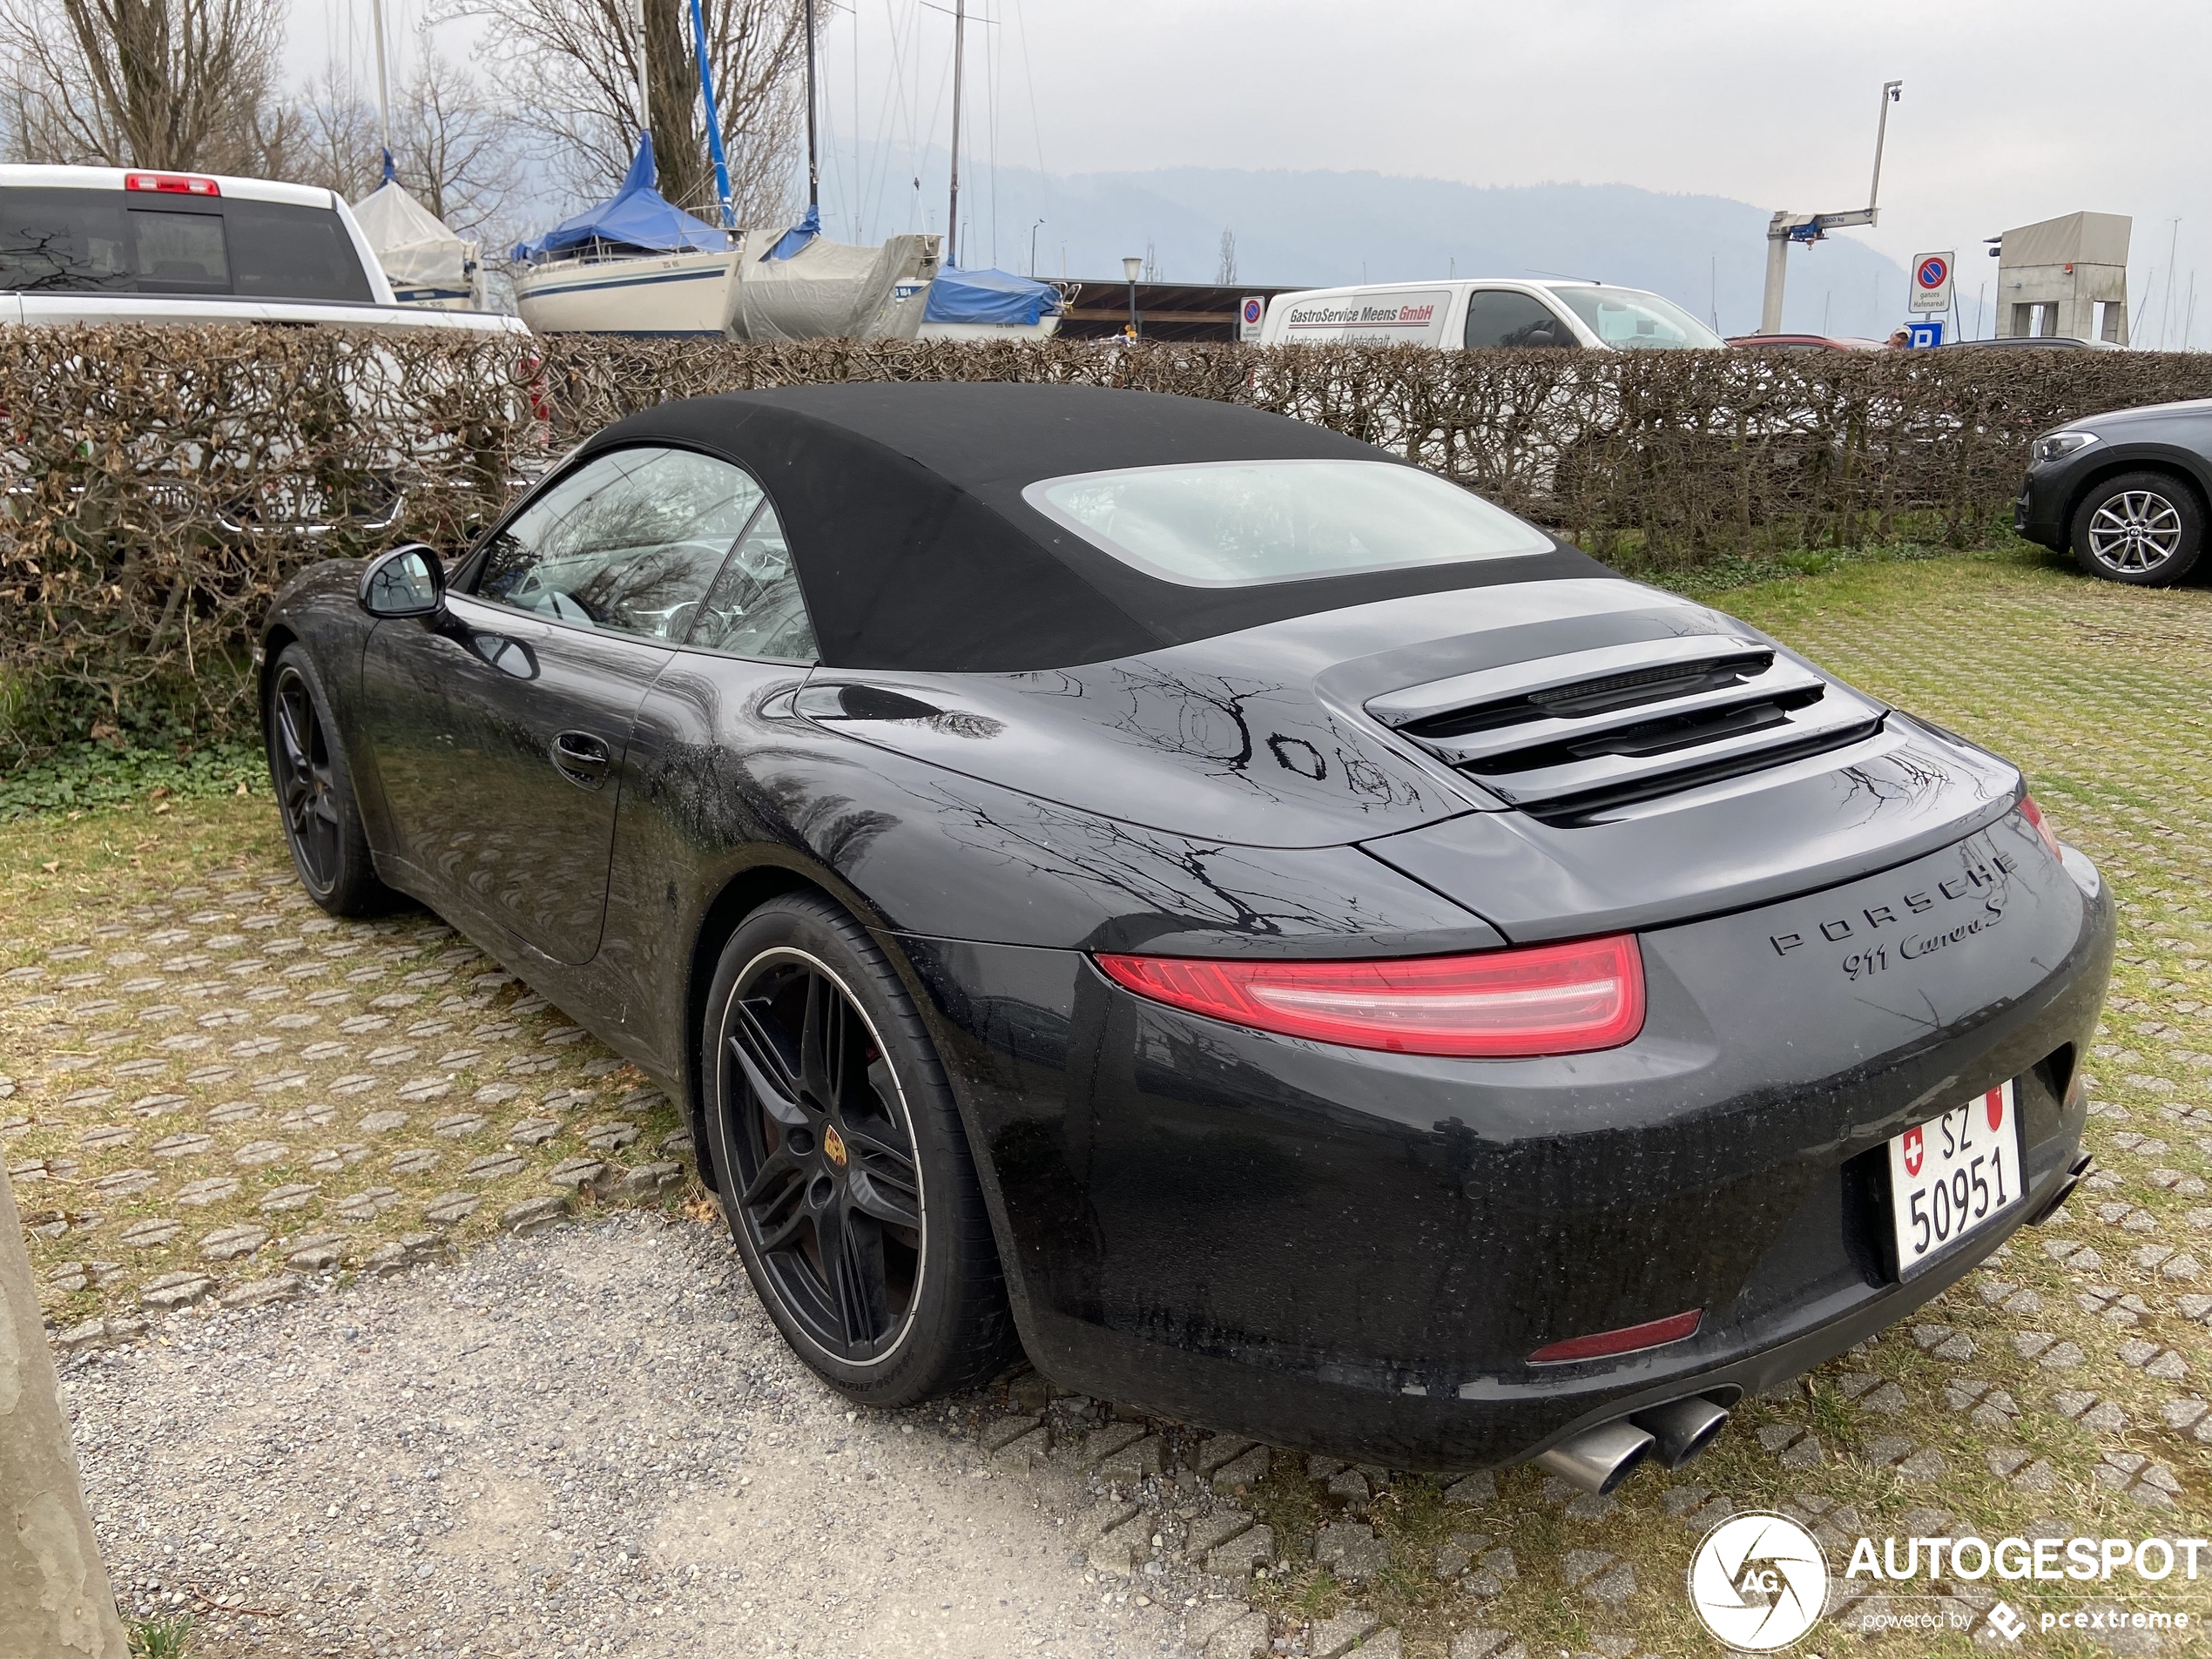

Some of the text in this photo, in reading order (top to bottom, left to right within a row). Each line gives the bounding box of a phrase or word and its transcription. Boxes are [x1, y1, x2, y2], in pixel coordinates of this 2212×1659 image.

[1290, 305, 1434, 323] GastroService Meens GmbH
[1913, 329, 1933, 348] P
[1770, 851, 2018, 956] PORSCHE
[1843, 896, 2005, 981] 911 Carrera S
[1939, 1102, 1973, 1159] SZ
[1910, 1146, 2006, 1254] 50951
